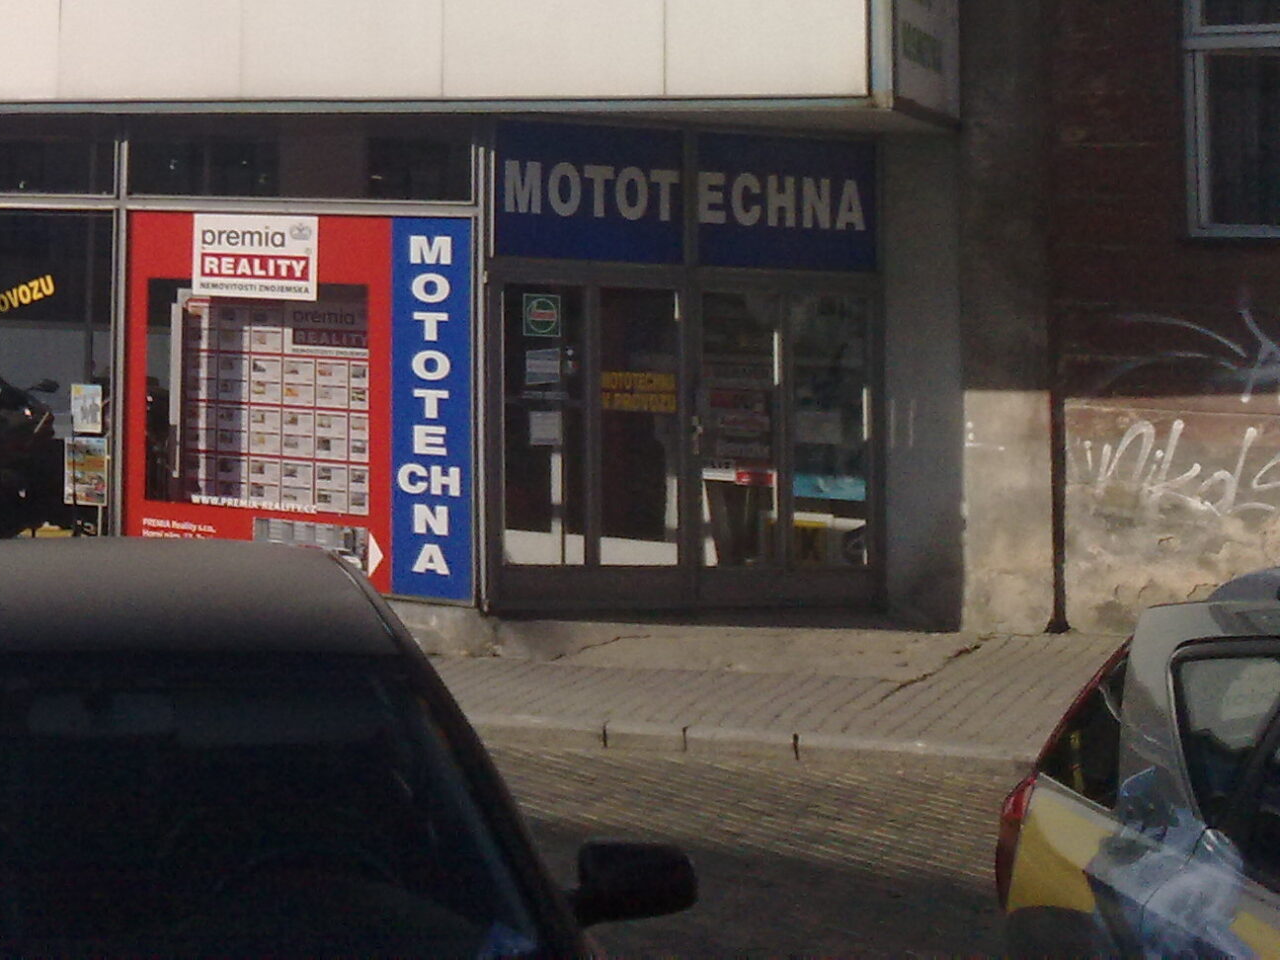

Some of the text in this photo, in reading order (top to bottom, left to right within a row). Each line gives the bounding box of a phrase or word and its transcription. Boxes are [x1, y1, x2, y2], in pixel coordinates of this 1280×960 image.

[201, 224, 286, 251] premia
[203, 255, 307, 279] REALITY
[199, 282, 257, 292] NEMOVITOSTI
[397, 234, 462, 576] MOTOTECHNA
